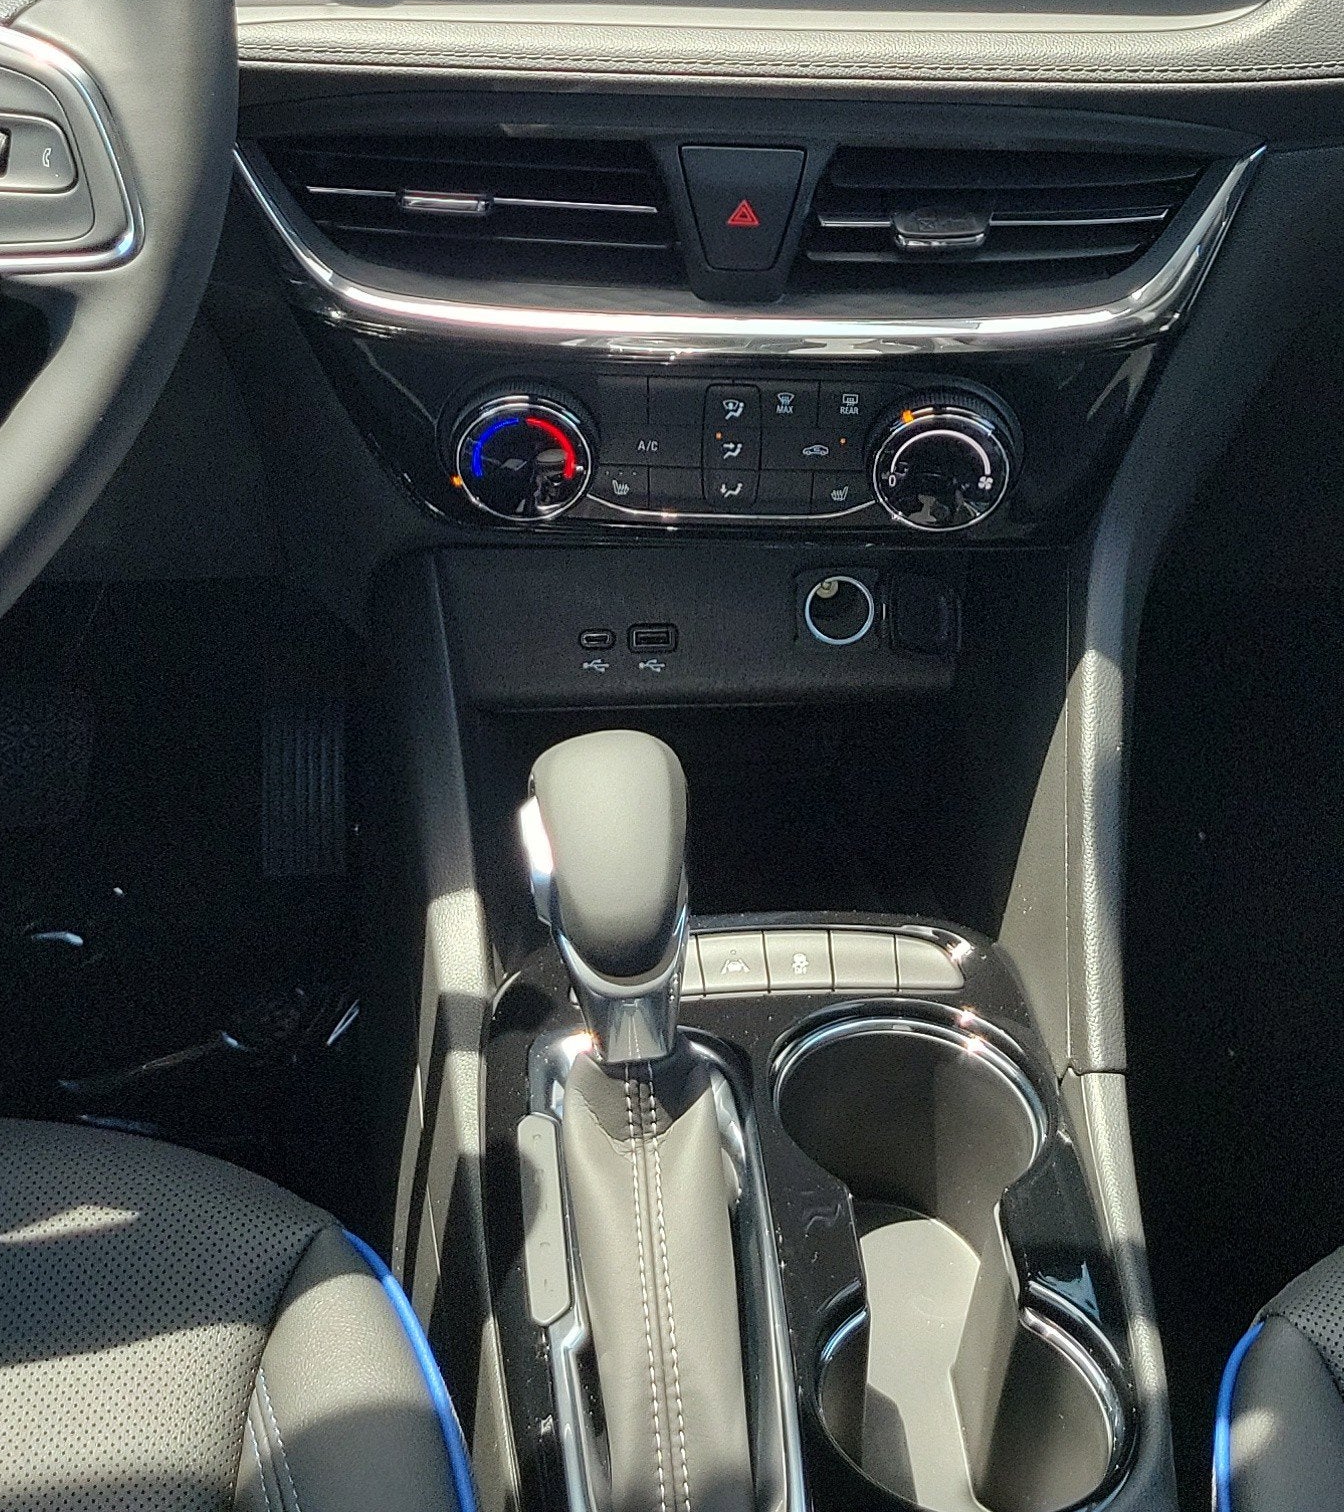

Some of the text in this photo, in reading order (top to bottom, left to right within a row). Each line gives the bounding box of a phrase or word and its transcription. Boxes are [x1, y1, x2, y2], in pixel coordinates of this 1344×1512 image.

[776, 404, 794, 414] MAX
[840, 405, 859, 415] REAR
[637, 439, 658, 451] A/C
